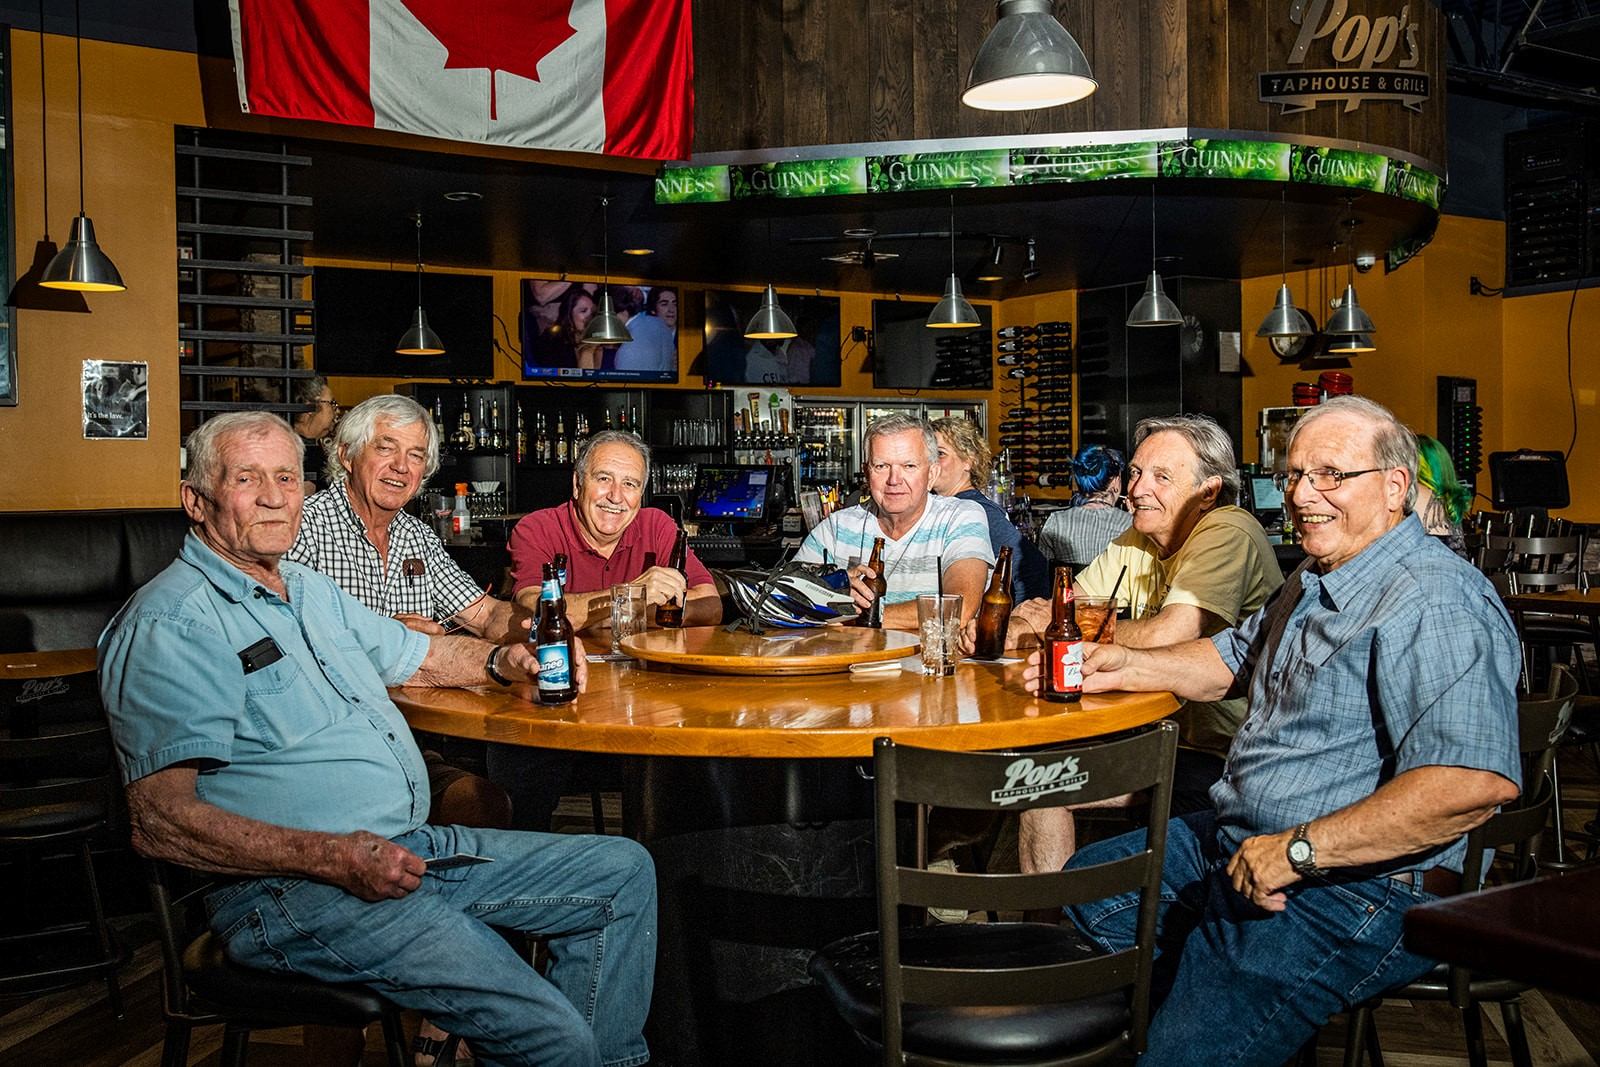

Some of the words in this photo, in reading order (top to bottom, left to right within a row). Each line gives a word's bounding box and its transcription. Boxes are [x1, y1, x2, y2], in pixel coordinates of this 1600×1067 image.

[1287, 0, 1420, 70] Pop's
[1271, 76, 1370, 93] TAPHOUSE
[1377, 76, 1387, 90] &
[1393, 77, 1425, 92] GRILL
[1033, 154, 1140, 175] GUINNESS
[1181, 146, 1276, 171] GUINNESS
[1306, 153, 1378, 180] GUINNESS
[751, 169, 850, 191] GUINNESS
[889, 161, 993, 187] GUINNESS
[539, 658, 564, 671] anee
[1005, 756, 1080, 791] Pop's
